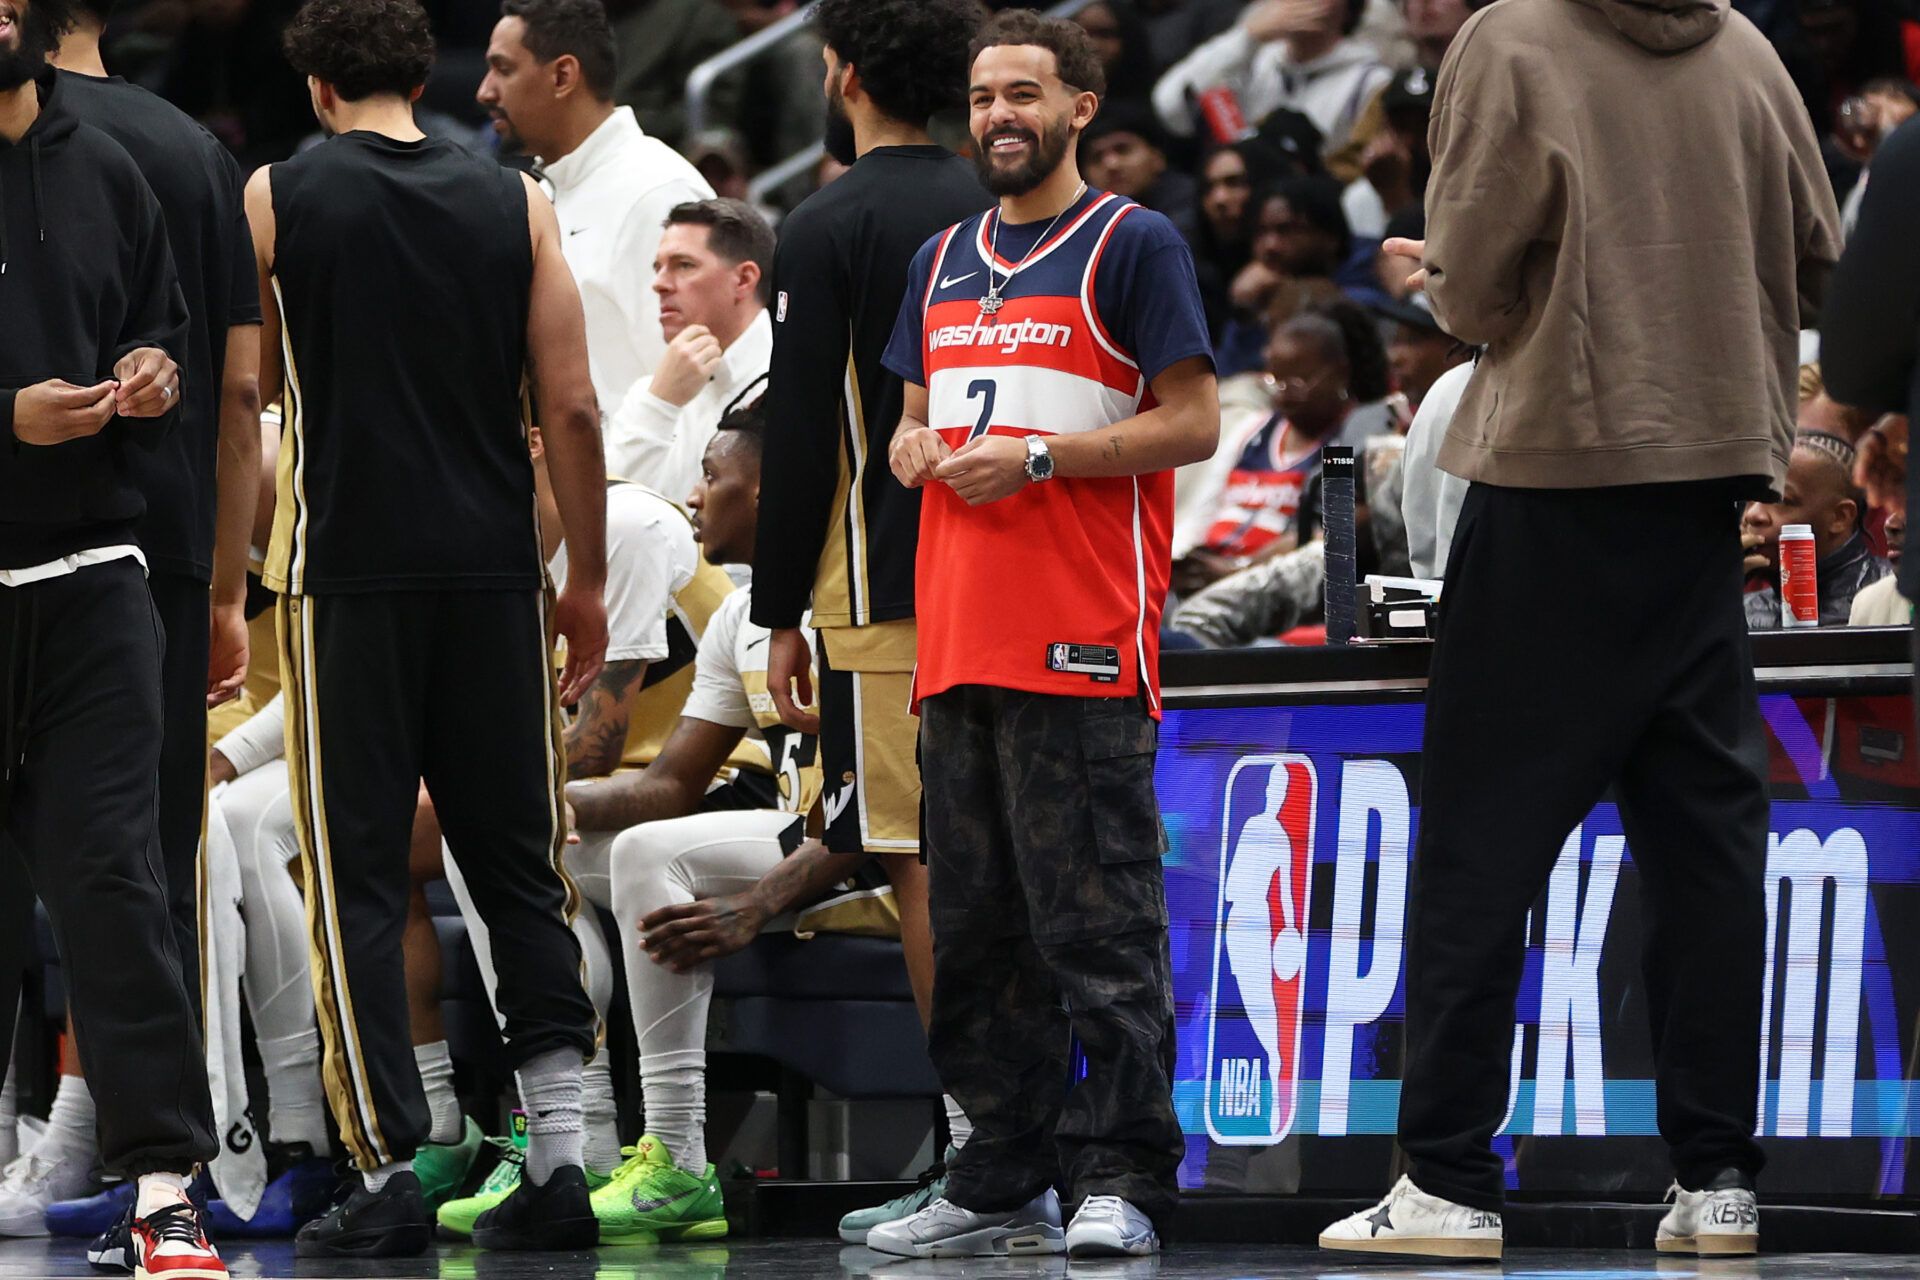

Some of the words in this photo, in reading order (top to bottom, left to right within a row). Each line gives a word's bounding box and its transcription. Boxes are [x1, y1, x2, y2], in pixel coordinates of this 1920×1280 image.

[929, 314, 1071, 353] washington
[966, 379, 997, 442] 2
[1218, 1058, 1261, 1116] NBA
